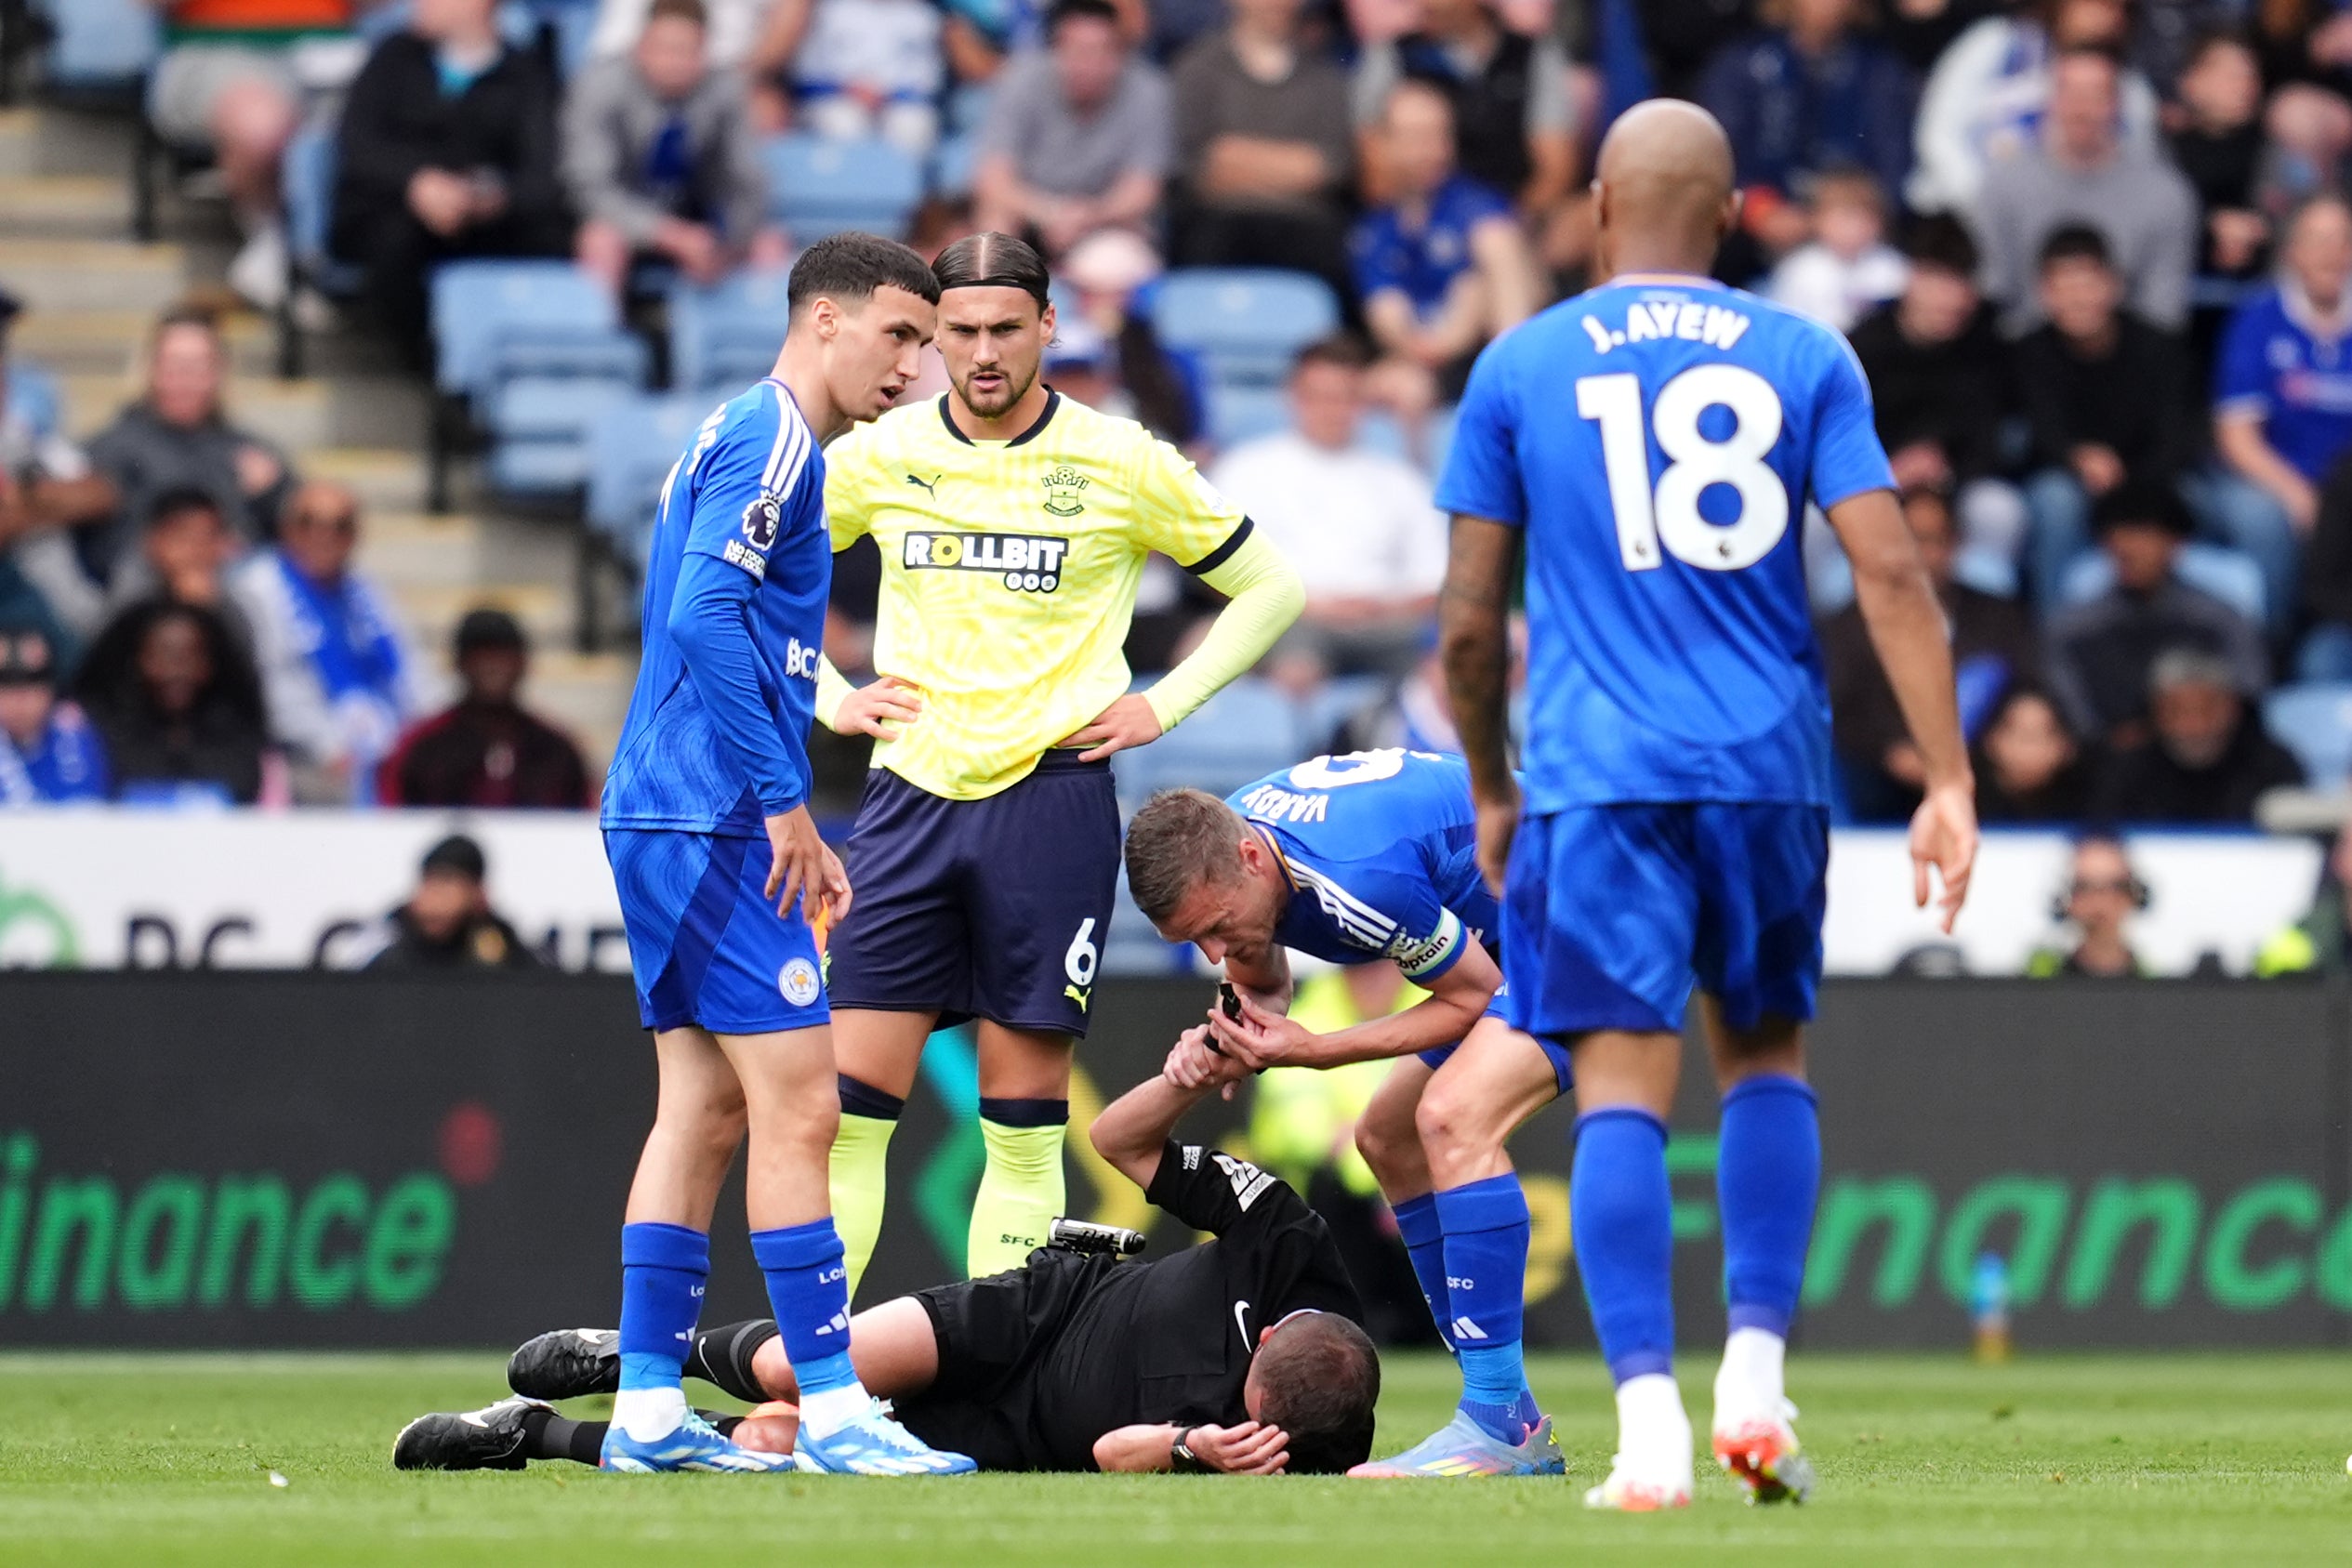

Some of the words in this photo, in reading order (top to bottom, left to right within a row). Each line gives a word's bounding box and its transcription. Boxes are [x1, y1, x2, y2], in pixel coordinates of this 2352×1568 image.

[1581, 302, 1751, 354] J.AYEW
[1575, 362, 1790, 573] 18
[904, 534, 1065, 573] ROLLBIT
[1241, 784, 1328, 823] VARDY
[1064, 918, 1097, 985] 6
[1397, 935, 1448, 971] aptain
[1000, 1233, 1036, 1247] SFC
